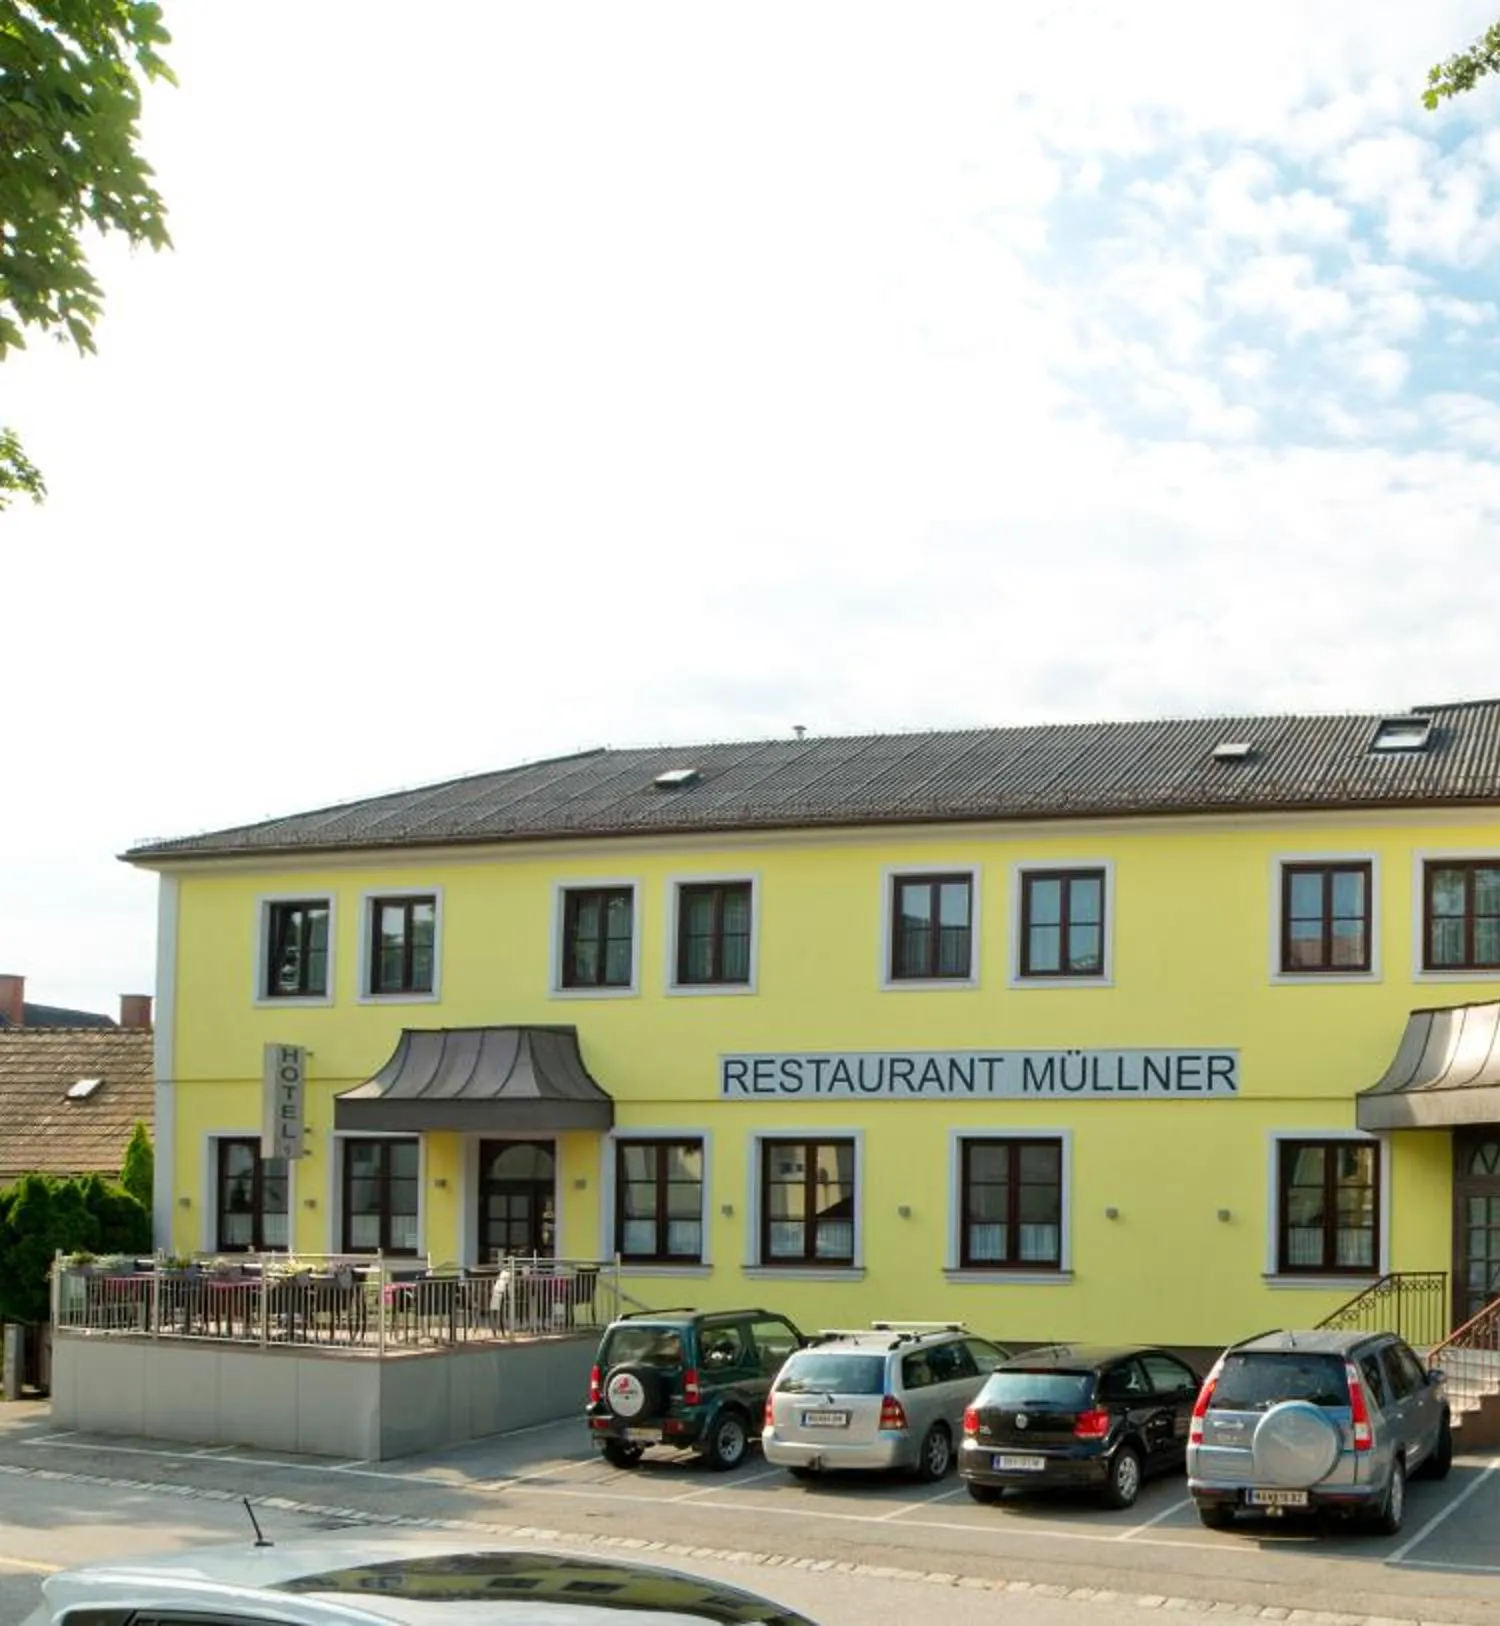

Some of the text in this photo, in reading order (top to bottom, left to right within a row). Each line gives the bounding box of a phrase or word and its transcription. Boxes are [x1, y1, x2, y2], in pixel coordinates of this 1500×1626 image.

[281, 1047, 299, 1138] HOTEL
[722, 1050, 1237, 1093] RESTAURANT MÜLLNER
